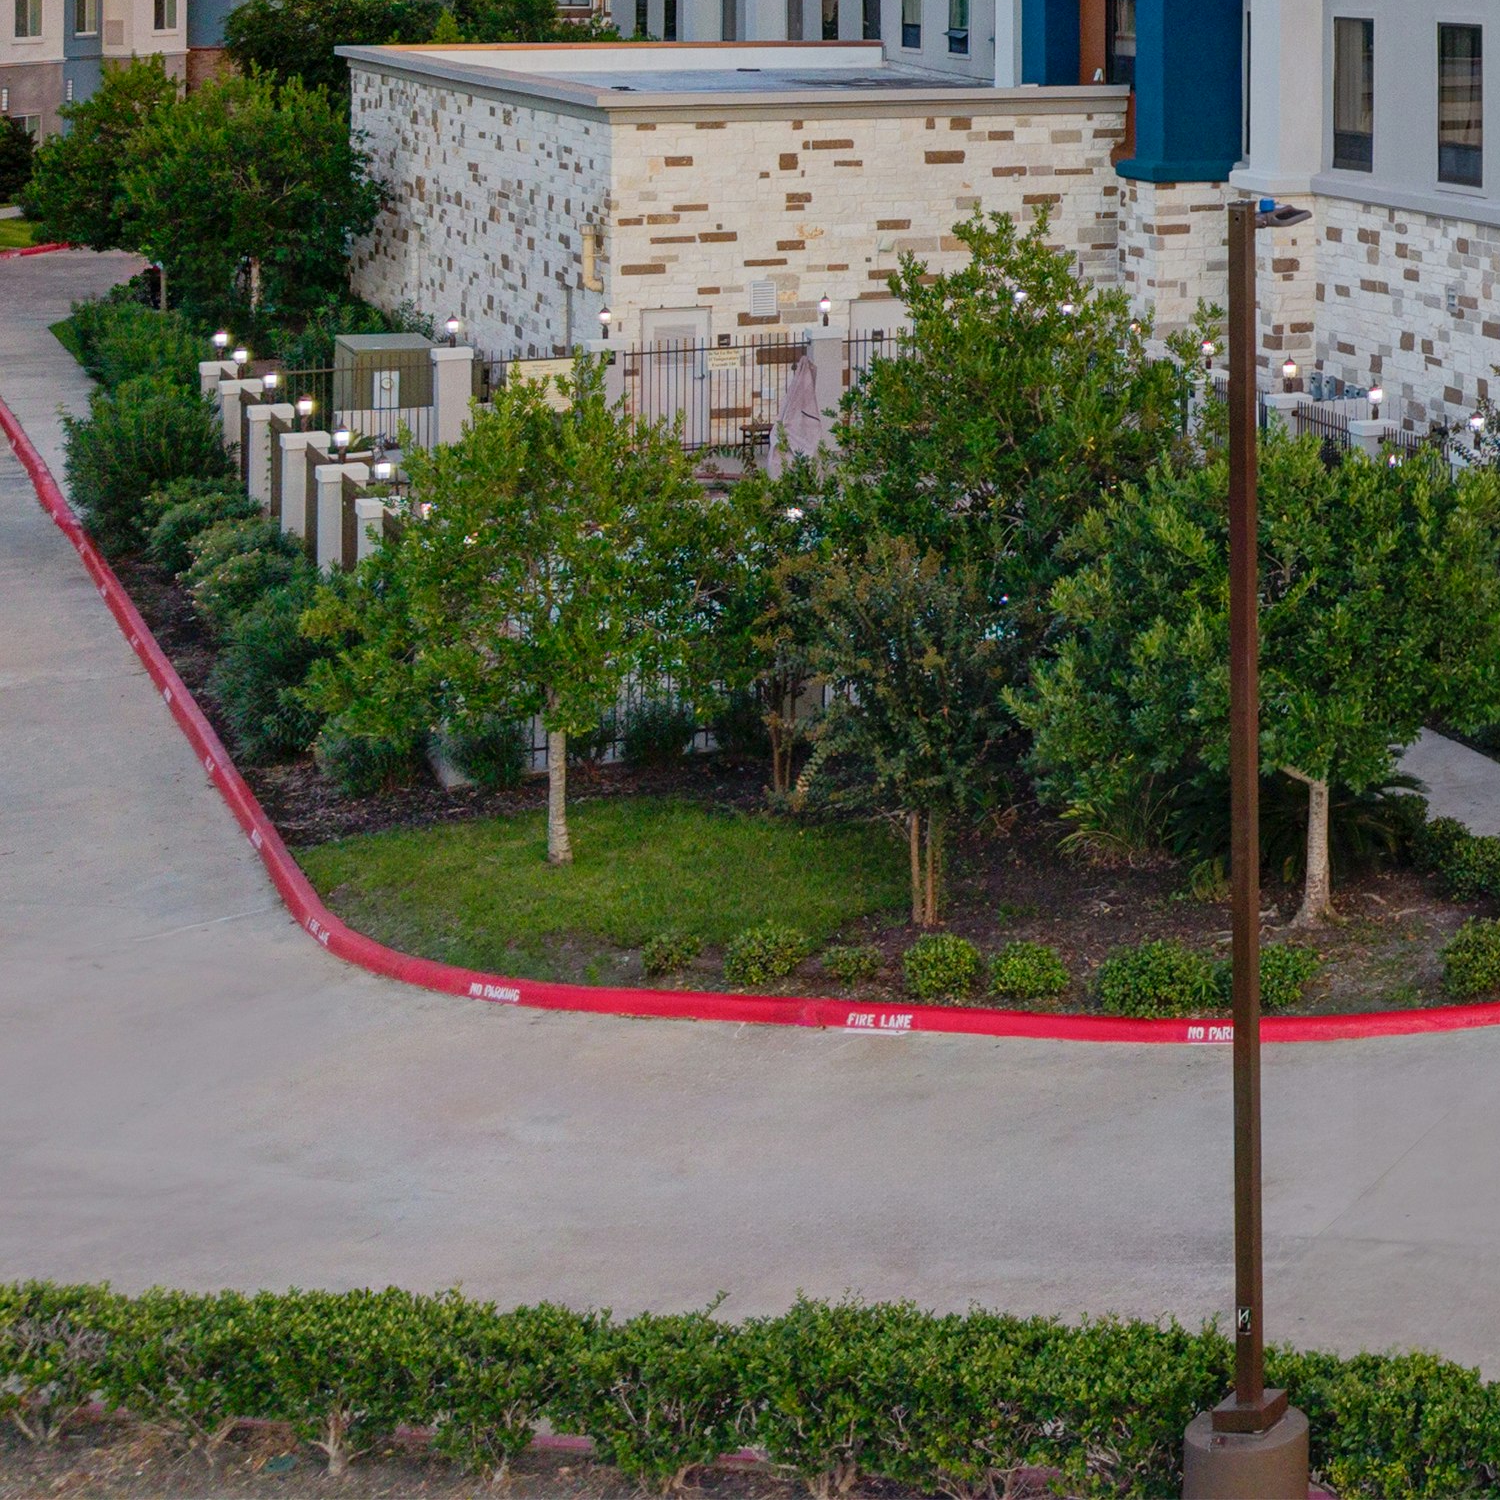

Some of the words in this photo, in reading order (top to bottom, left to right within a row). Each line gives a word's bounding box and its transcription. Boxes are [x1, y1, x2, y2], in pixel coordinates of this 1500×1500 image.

[468, 982, 483, 996] NO
[484, 984, 520, 1002] PARKING
[846, 1012, 876, 1027] FIRE
[880, 1013, 913, 1029] LANE
[1187, 1026, 1205, 1039] NO
